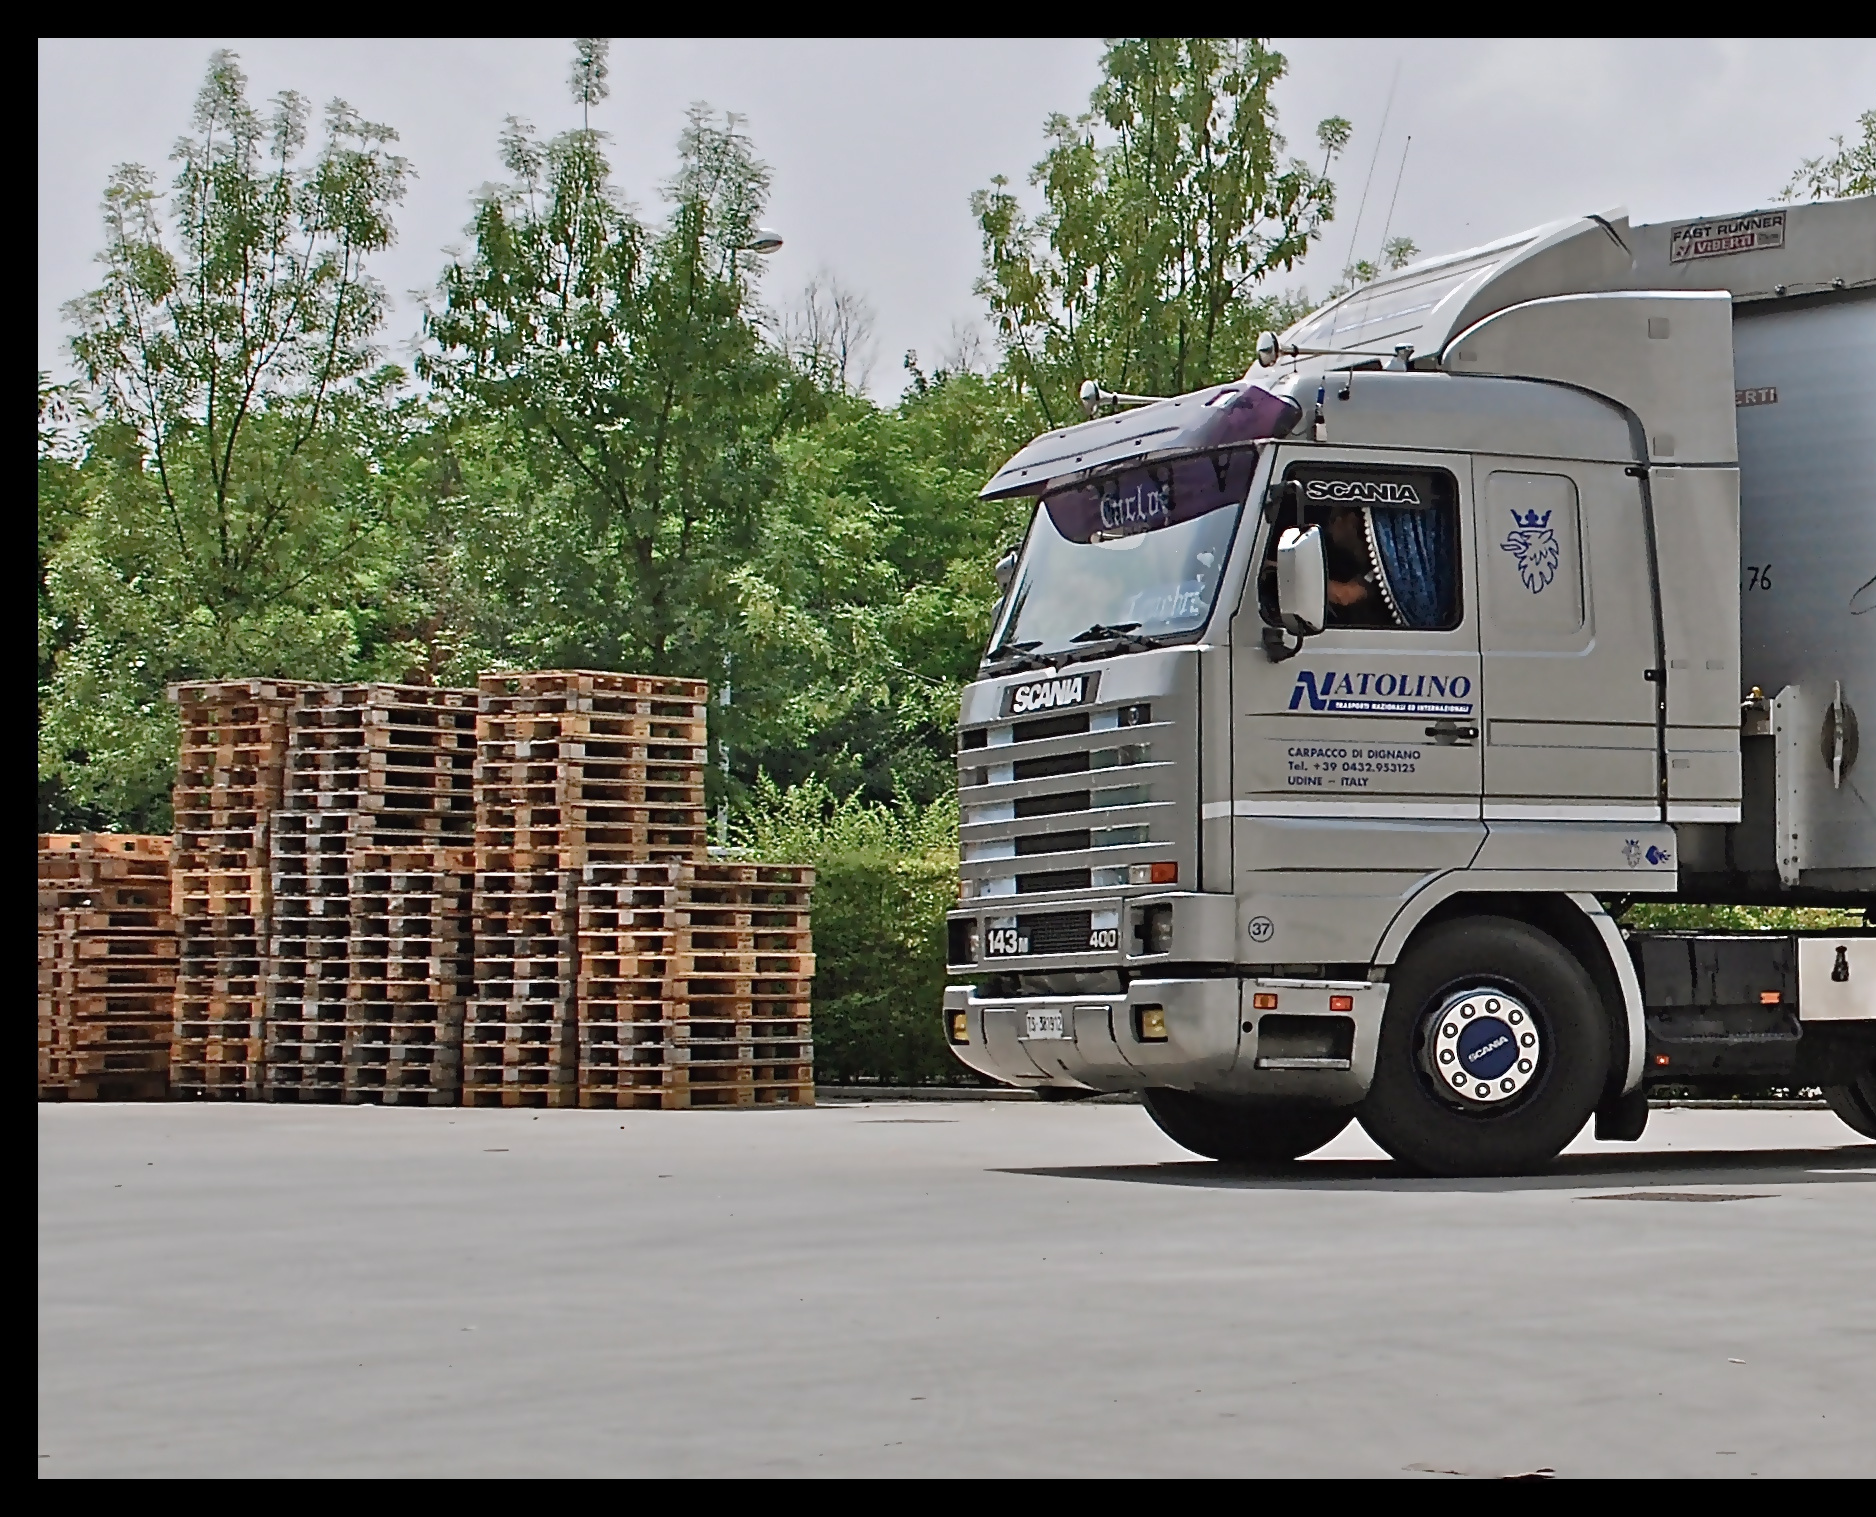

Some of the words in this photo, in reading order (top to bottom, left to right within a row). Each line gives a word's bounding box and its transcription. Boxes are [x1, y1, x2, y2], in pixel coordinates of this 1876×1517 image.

[1673, 227, 1712, 241] FAST
[1718, 216, 1782, 235] RUNNER
[1697, 235, 1752, 253] VIBERTI
[1306, 480, 1420, 504] SCANIA
[1013, 677, 1082, 712] SCANIA
[1288, 671, 1471, 710] NATOLINO
[1288, 748, 1347, 759] CARPACCO
[1352, 750, 1363, 759] DI
[1367, 750, 1421, 760] DIGNANO
[1288, 761, 1308, 771] Tel.
[1313, 762, 1337, 771] +39
[1342, 762, 1415, 773] 0432.953125
[1288, 776, 1322, 786] UDINE
[1341, 777, 1369, 786] ITALY
[1252, 922, 1270, 936] 37
[1089, 930, 1117, 948] 400
[1468, 1035, 1509, 1062] SCANIA
